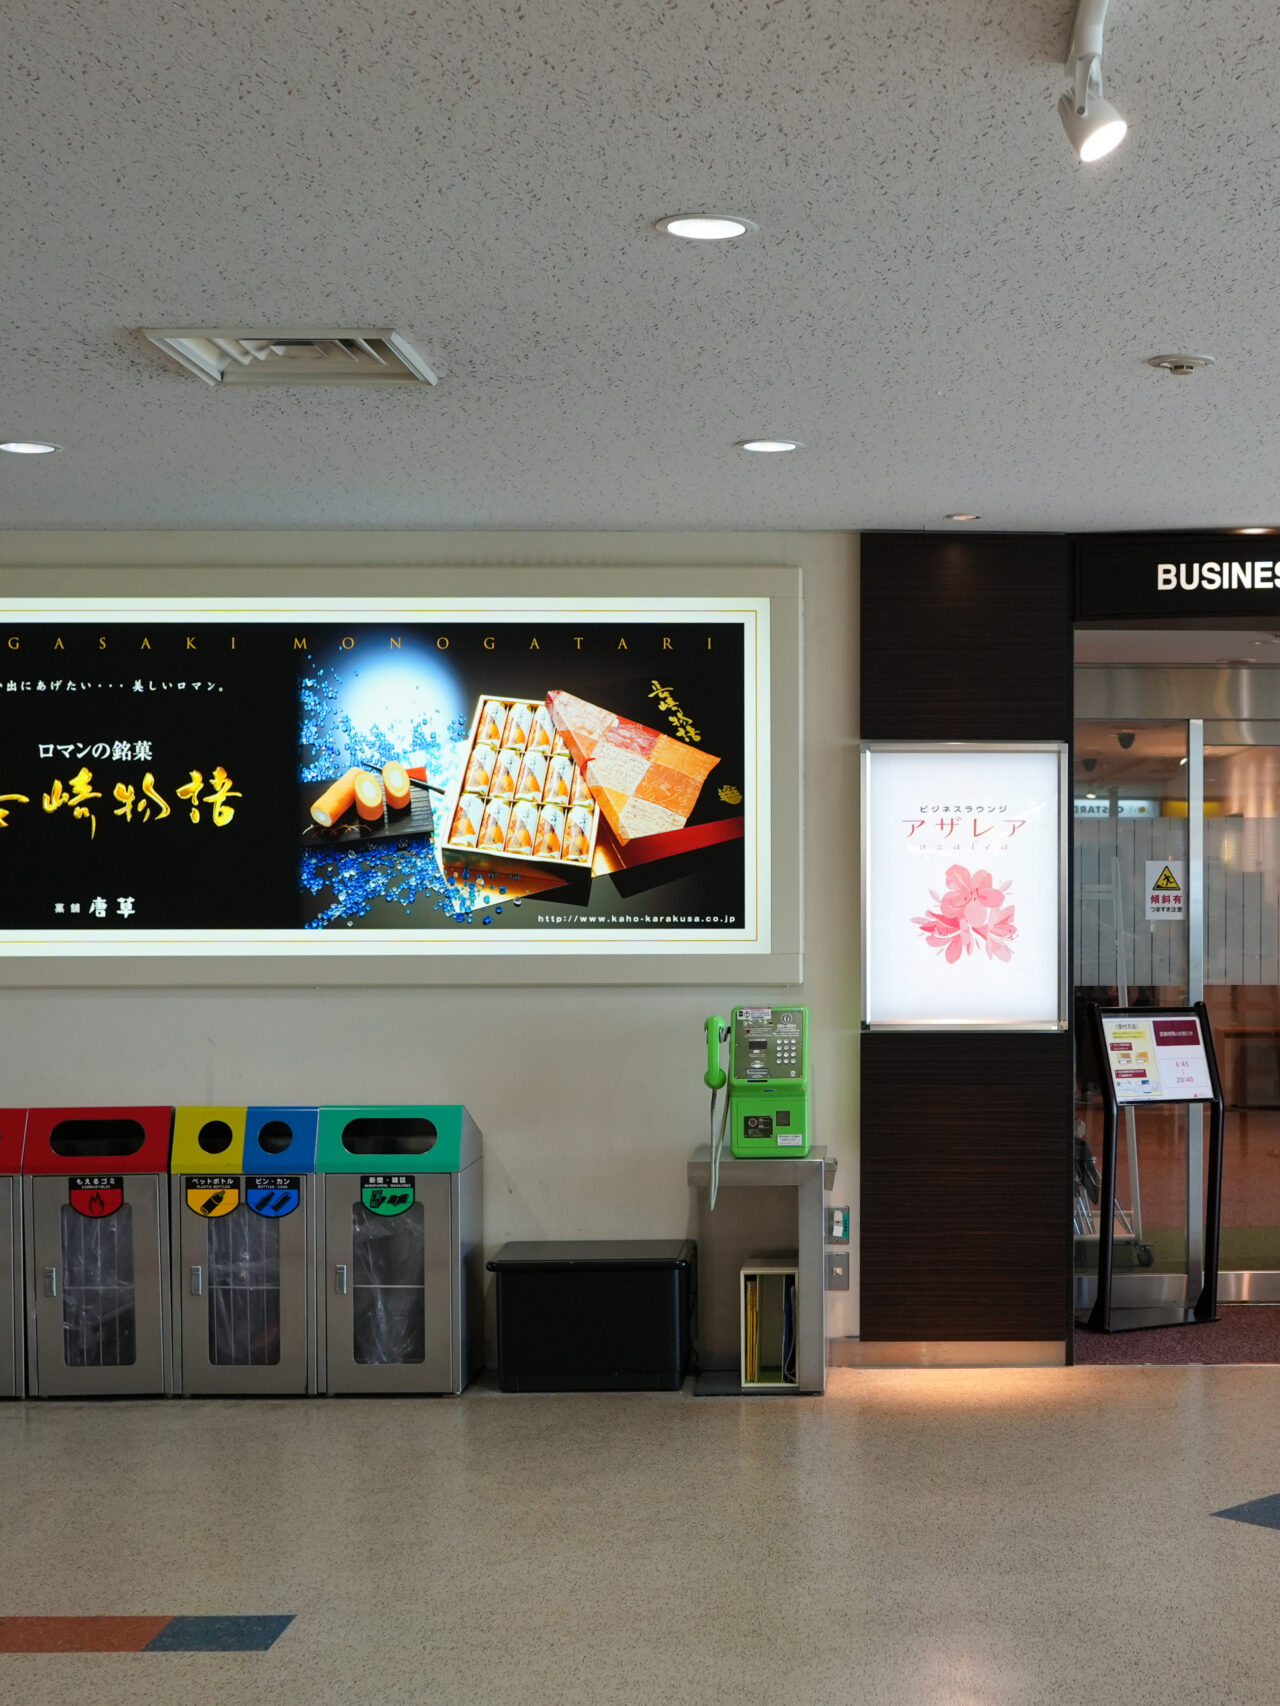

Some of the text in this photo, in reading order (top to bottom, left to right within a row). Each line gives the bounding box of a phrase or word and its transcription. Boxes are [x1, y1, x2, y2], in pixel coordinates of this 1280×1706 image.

[7, 637, 713, 650] GASAKI MONOGATARI
[38, 741, 153, 762] ロマンの銘菓
[919, 805, 1008, 813] ビジネスラウンジ
[901, 816, 1027, 838] アザレア
[1151, 894, 1183, 905] 傾斜有
[89, 897, 136, 918] 唐草
[537, 914, 737, 924] http://www.kaho-karakusa.co.jp
[76, 1178, 115, 1186] もえるゴミ
[192, 1177, 234, 1185] ペットボトル
